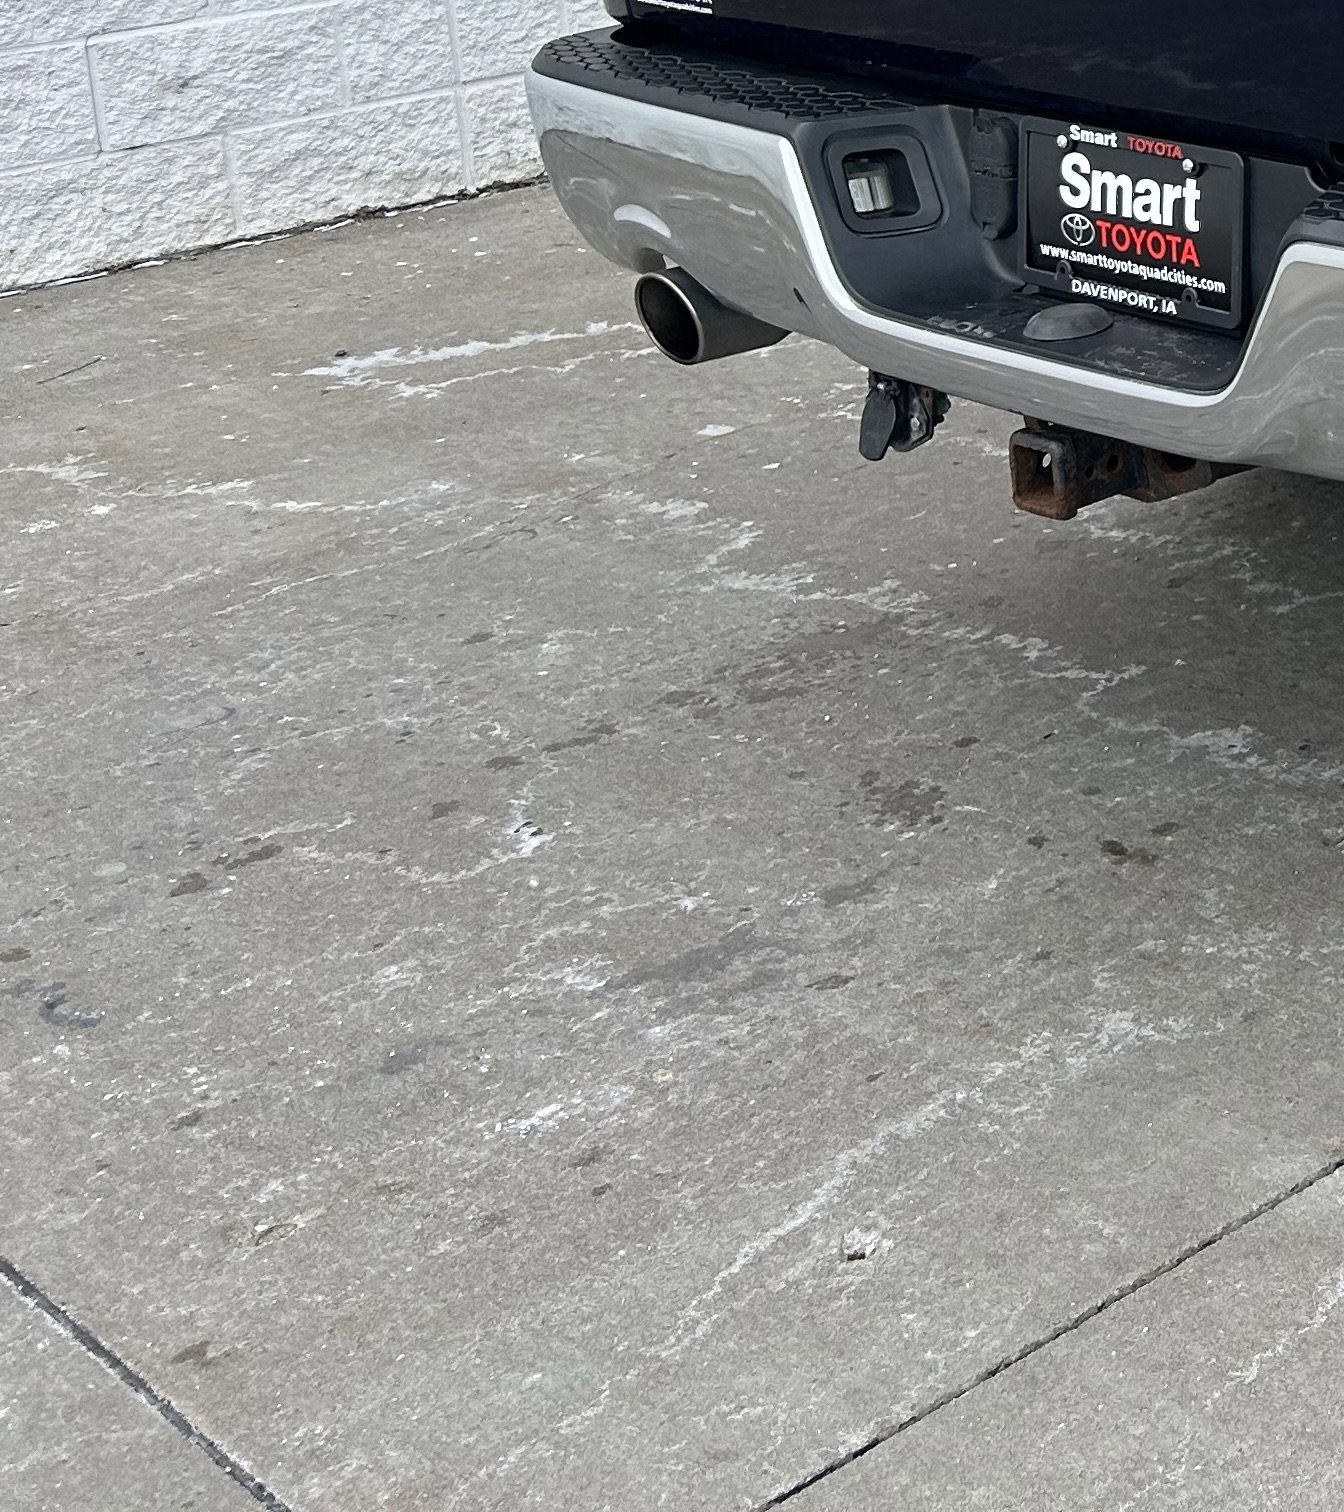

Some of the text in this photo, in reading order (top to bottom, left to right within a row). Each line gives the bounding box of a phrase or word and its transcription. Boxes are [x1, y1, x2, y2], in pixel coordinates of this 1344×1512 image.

[1069, 124, 1183, 159] Smart TOYOTA
[1059, 151, 1201, 233] Smart
[1096, 219, 1200, 268] TOYOTA
[1040, 243, 1227, 294] www.smarttoyotaquadcities.com
[1071, 279, 1178, 315] DAVENPORT, IA
